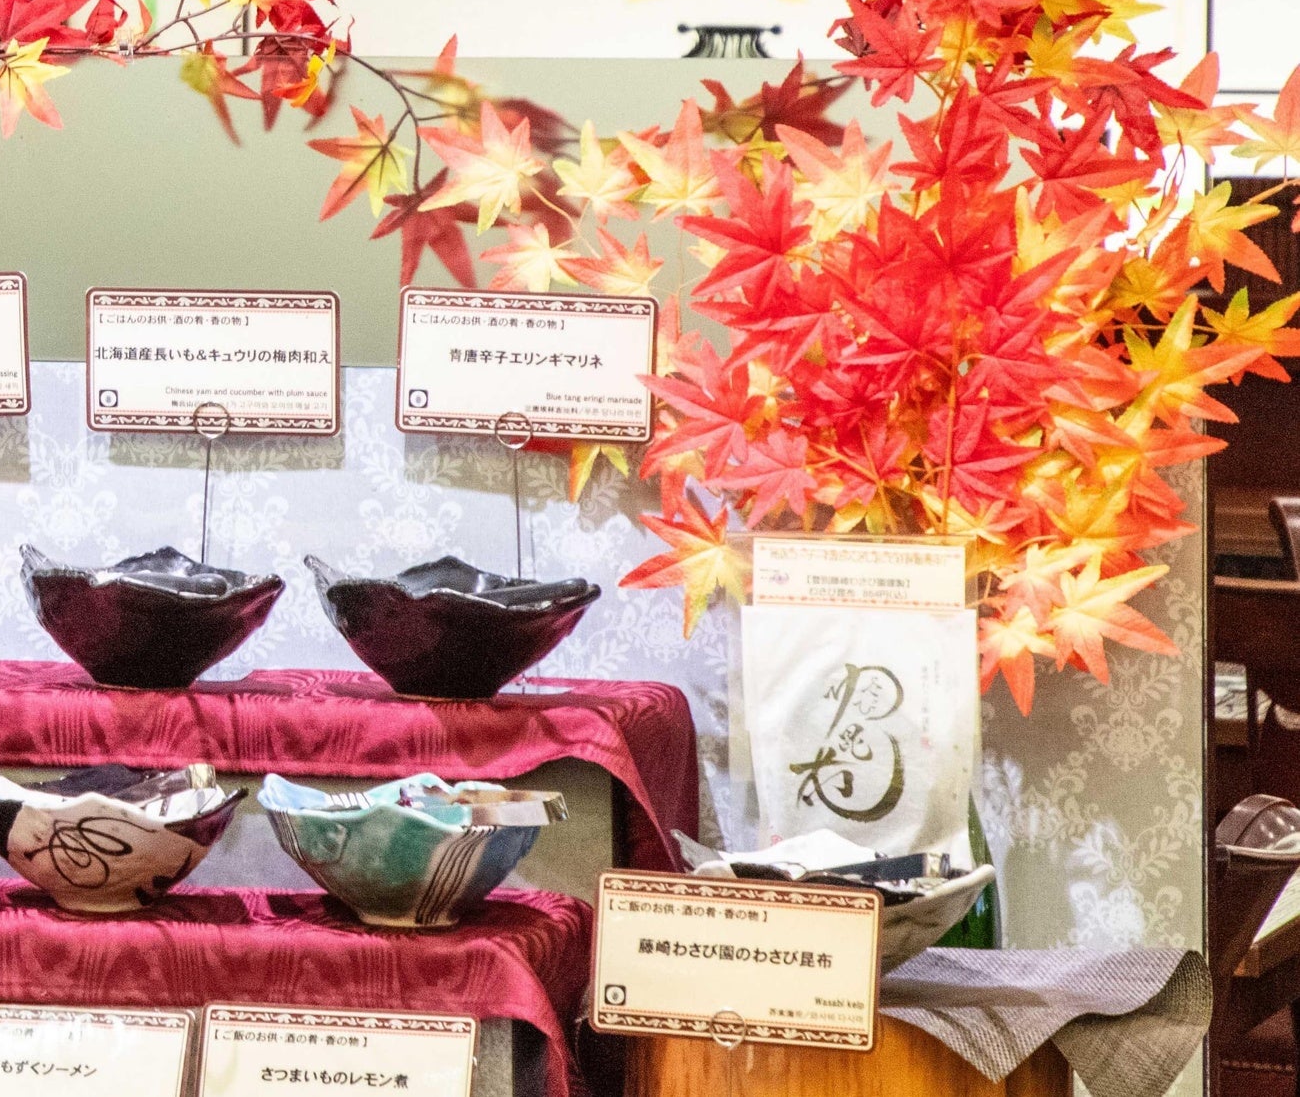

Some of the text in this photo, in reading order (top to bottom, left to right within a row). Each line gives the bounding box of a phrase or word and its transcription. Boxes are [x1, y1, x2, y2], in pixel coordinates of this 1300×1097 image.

[165, 387, 194, 395] Chinese
[214, 388, 228, 396] and
[229, 388, 267, 396] cucumber
[268, 389, 285, 397] with
[0, 1060, 96, 1077] もずくソーメン
[261, 1067, 408, 1088] さつまいものレモン煮
